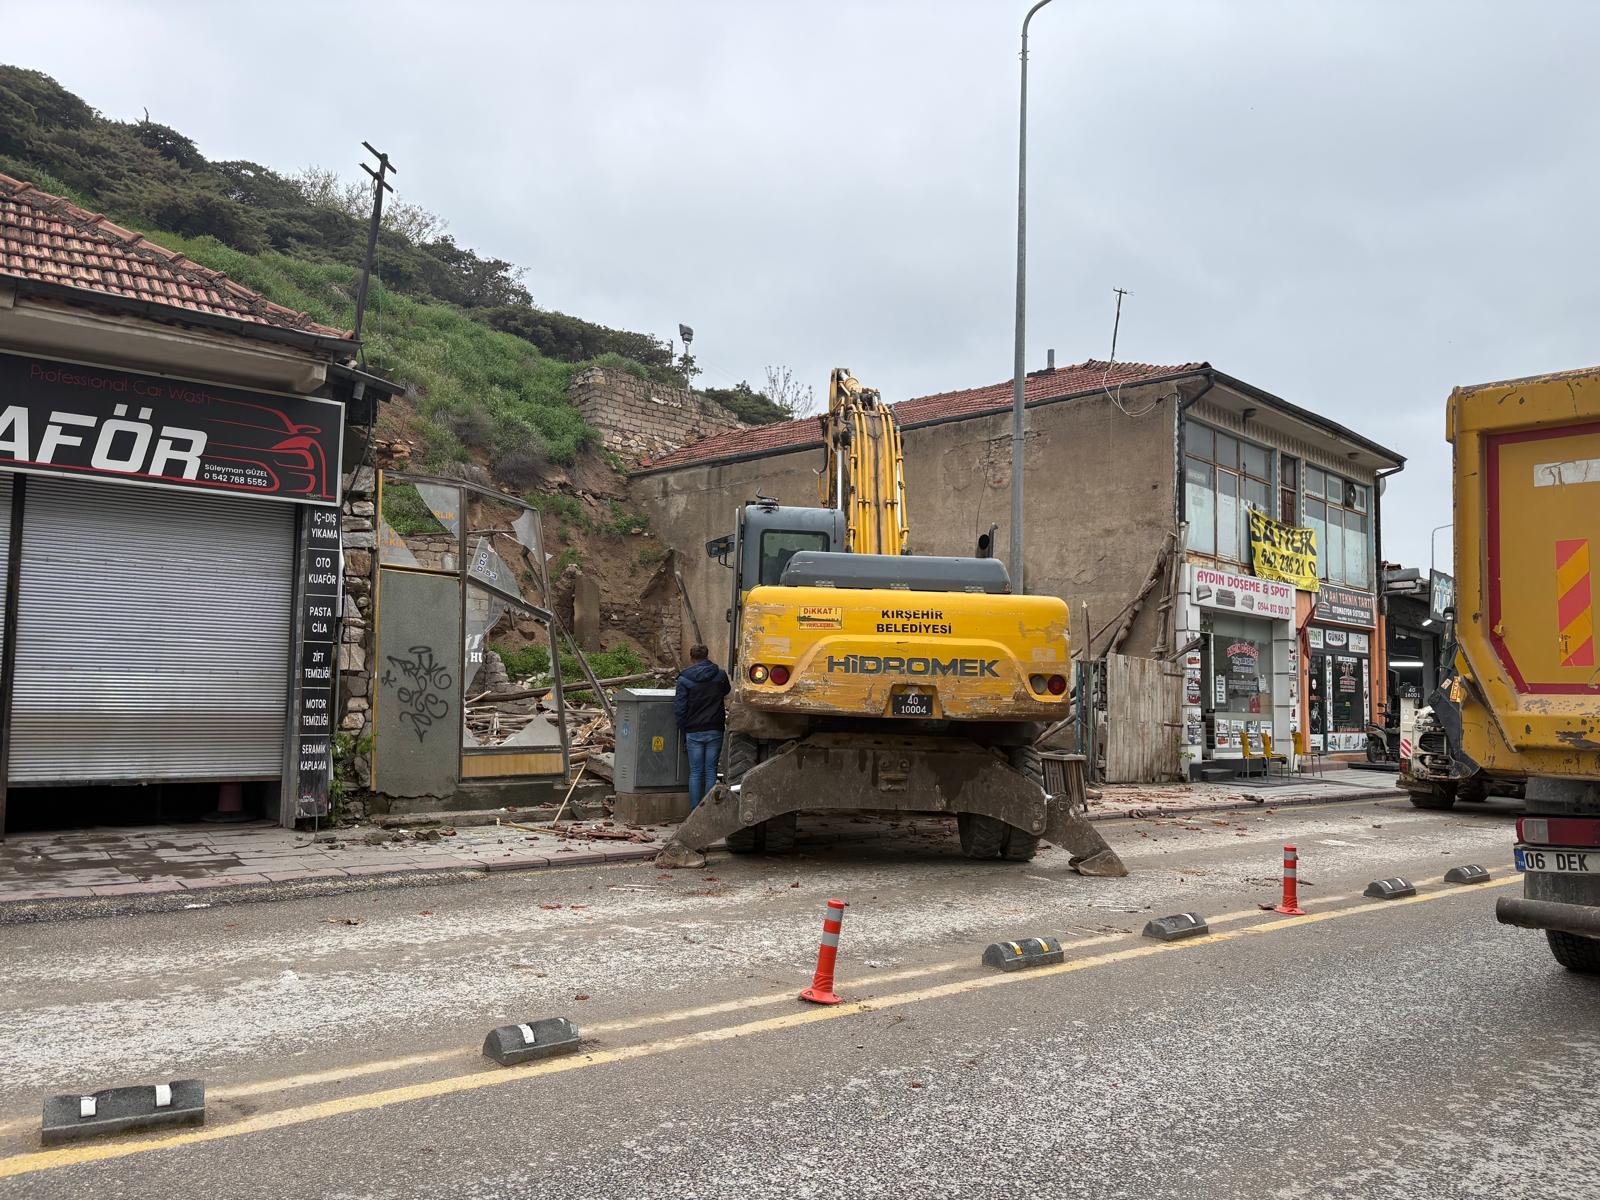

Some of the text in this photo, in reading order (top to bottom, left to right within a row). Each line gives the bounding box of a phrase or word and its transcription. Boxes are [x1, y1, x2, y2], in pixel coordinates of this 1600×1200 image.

[30, 364, 213, 405] Professional Car Wash
[204, 463, 268, 477] Süleyman GÜZEL
[212, 473, 228, 482] 542
[230, 475, 245, 484] 768
[247, 477, 268, 487] 5552
[313, 511, 337, 526] İÇ-DIŞ
[311, 527, 338, 539] YIKAMA
[315, 557, 331, 568] OTO
[308, 573, 336, 585] KUAFÖR
[1197, 570, 1225, 586] AYDIN
[1227, 576, 1260, 593] DÖŞEME
[1262, 584, 1269, 594] &
[1270, 585, 1289, 598] SPOT
[309, 606, 332, 617] PASTA
[803, 607, 833, 615] DİKKAT
[881, 608, 943, 621] KIRŞEHİR
[311, 621, 328, 633] CİLA
[876, 622, 952, 634] BELEDİYESİ
[827, 654, 1000, 678] HİDROMEK
[305, 699, 326, 709] MOTOR
[907, 695, 919, 705] 40
[901, 705, 927, 714] 10004
[302, 742, 326, 754] SERAMİK
[1525, 852, 1589, 871] 06 DEK
